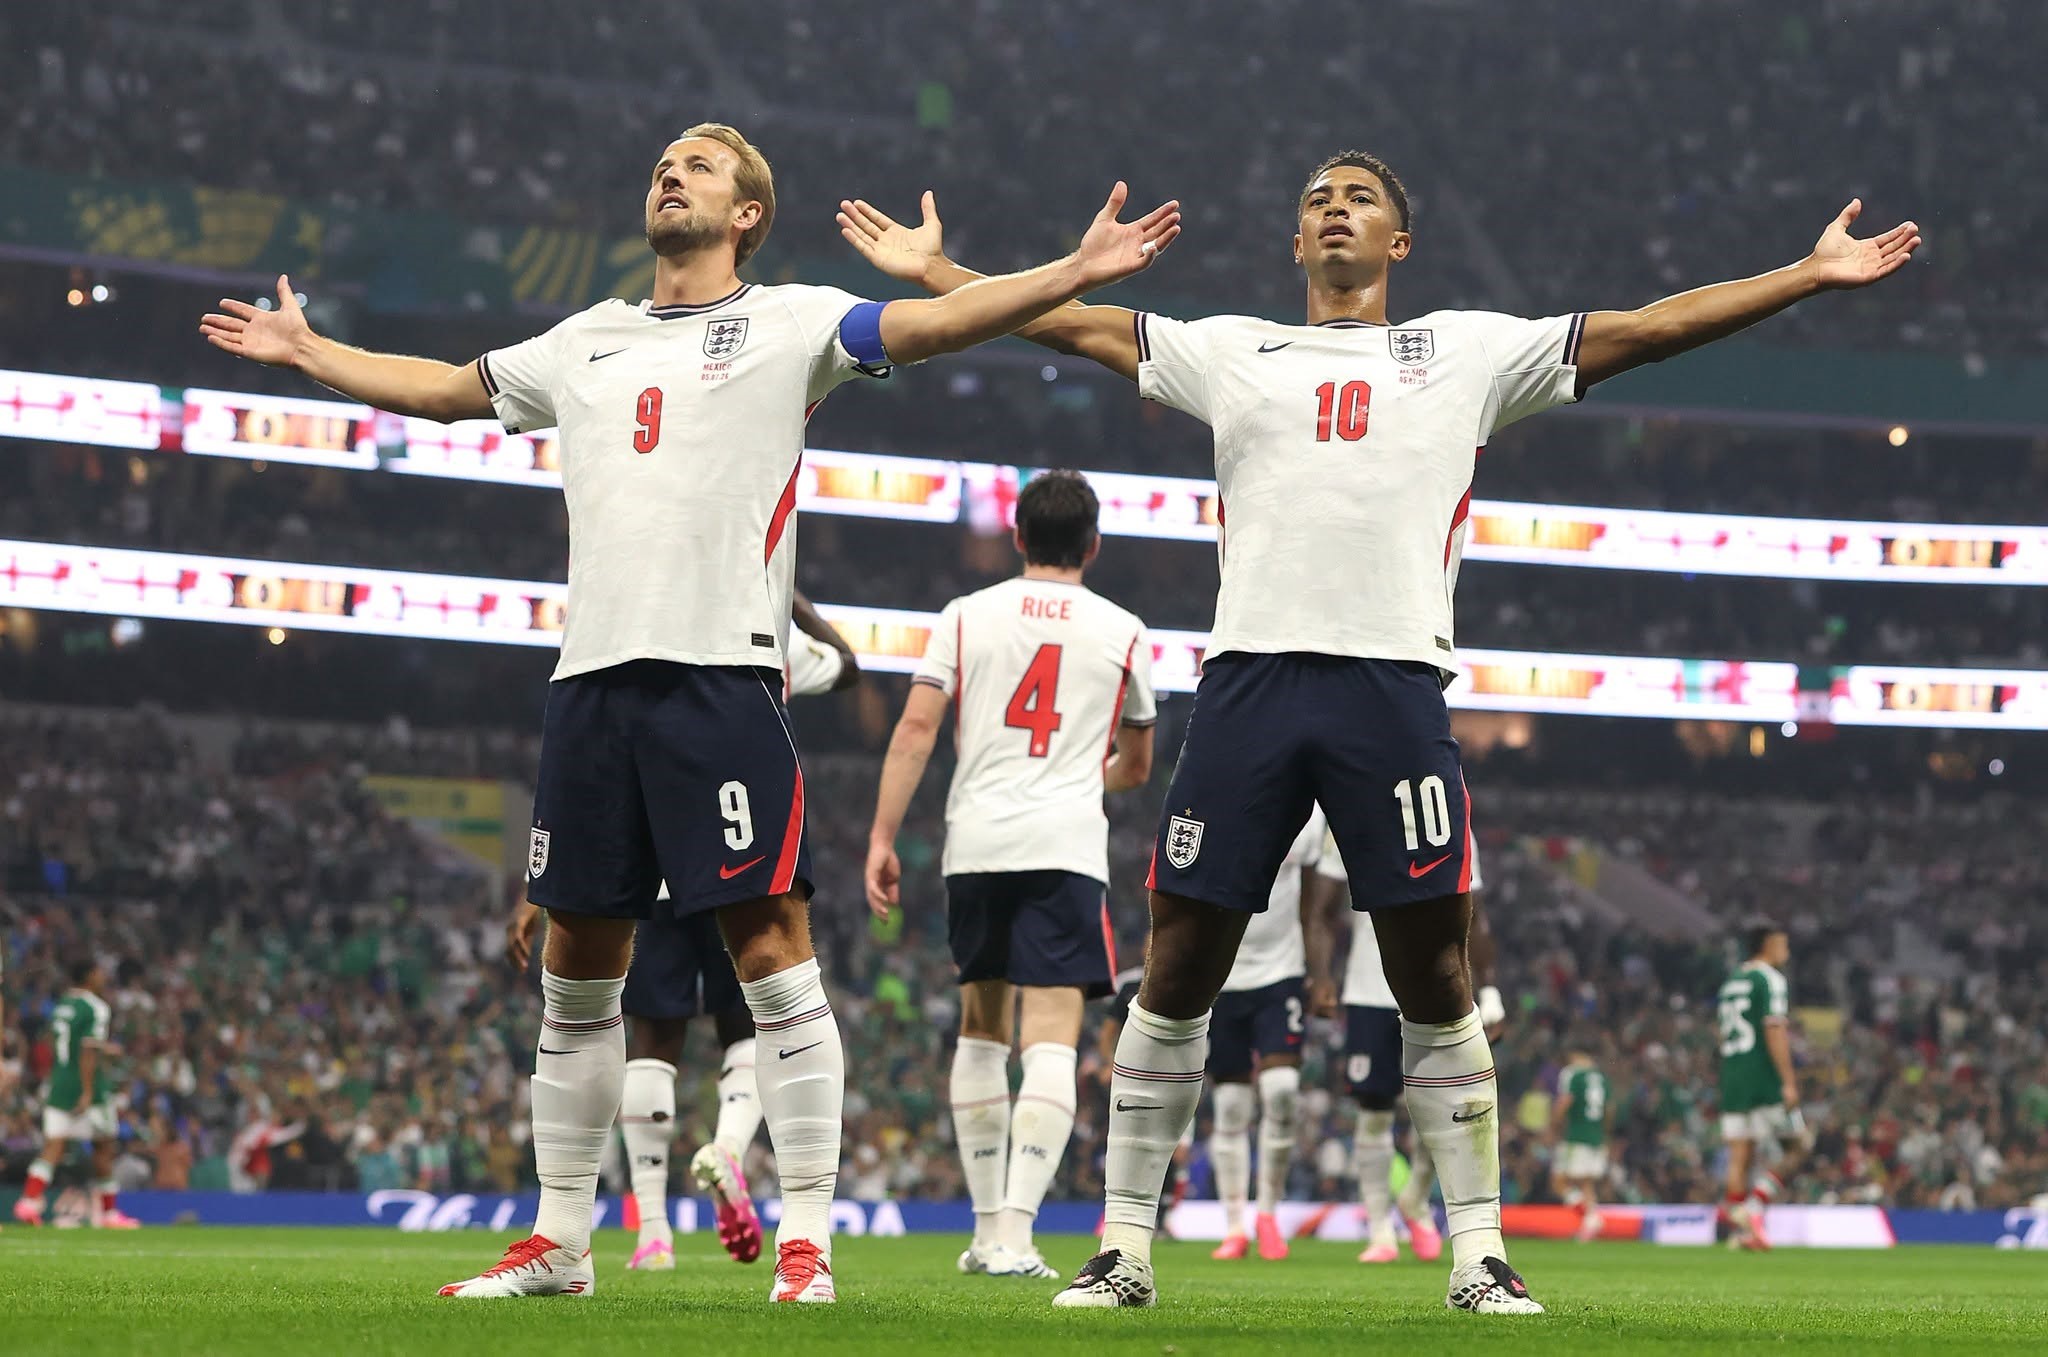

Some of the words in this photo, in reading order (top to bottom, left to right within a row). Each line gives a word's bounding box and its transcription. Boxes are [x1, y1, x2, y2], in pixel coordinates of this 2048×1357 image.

[703, 362, 732, 371] MEXICO
[633, 387, 663, 454] 9
[1315, 380, 1372, 442] 10
[1021, 595, 1072, 620] RICE
[1004, 643, 1063, 758] 4
[718, 780, 754, 851] 9
[1393, 775, 1452, 851] 10
[1285, 996, 1304, 1033] 2
